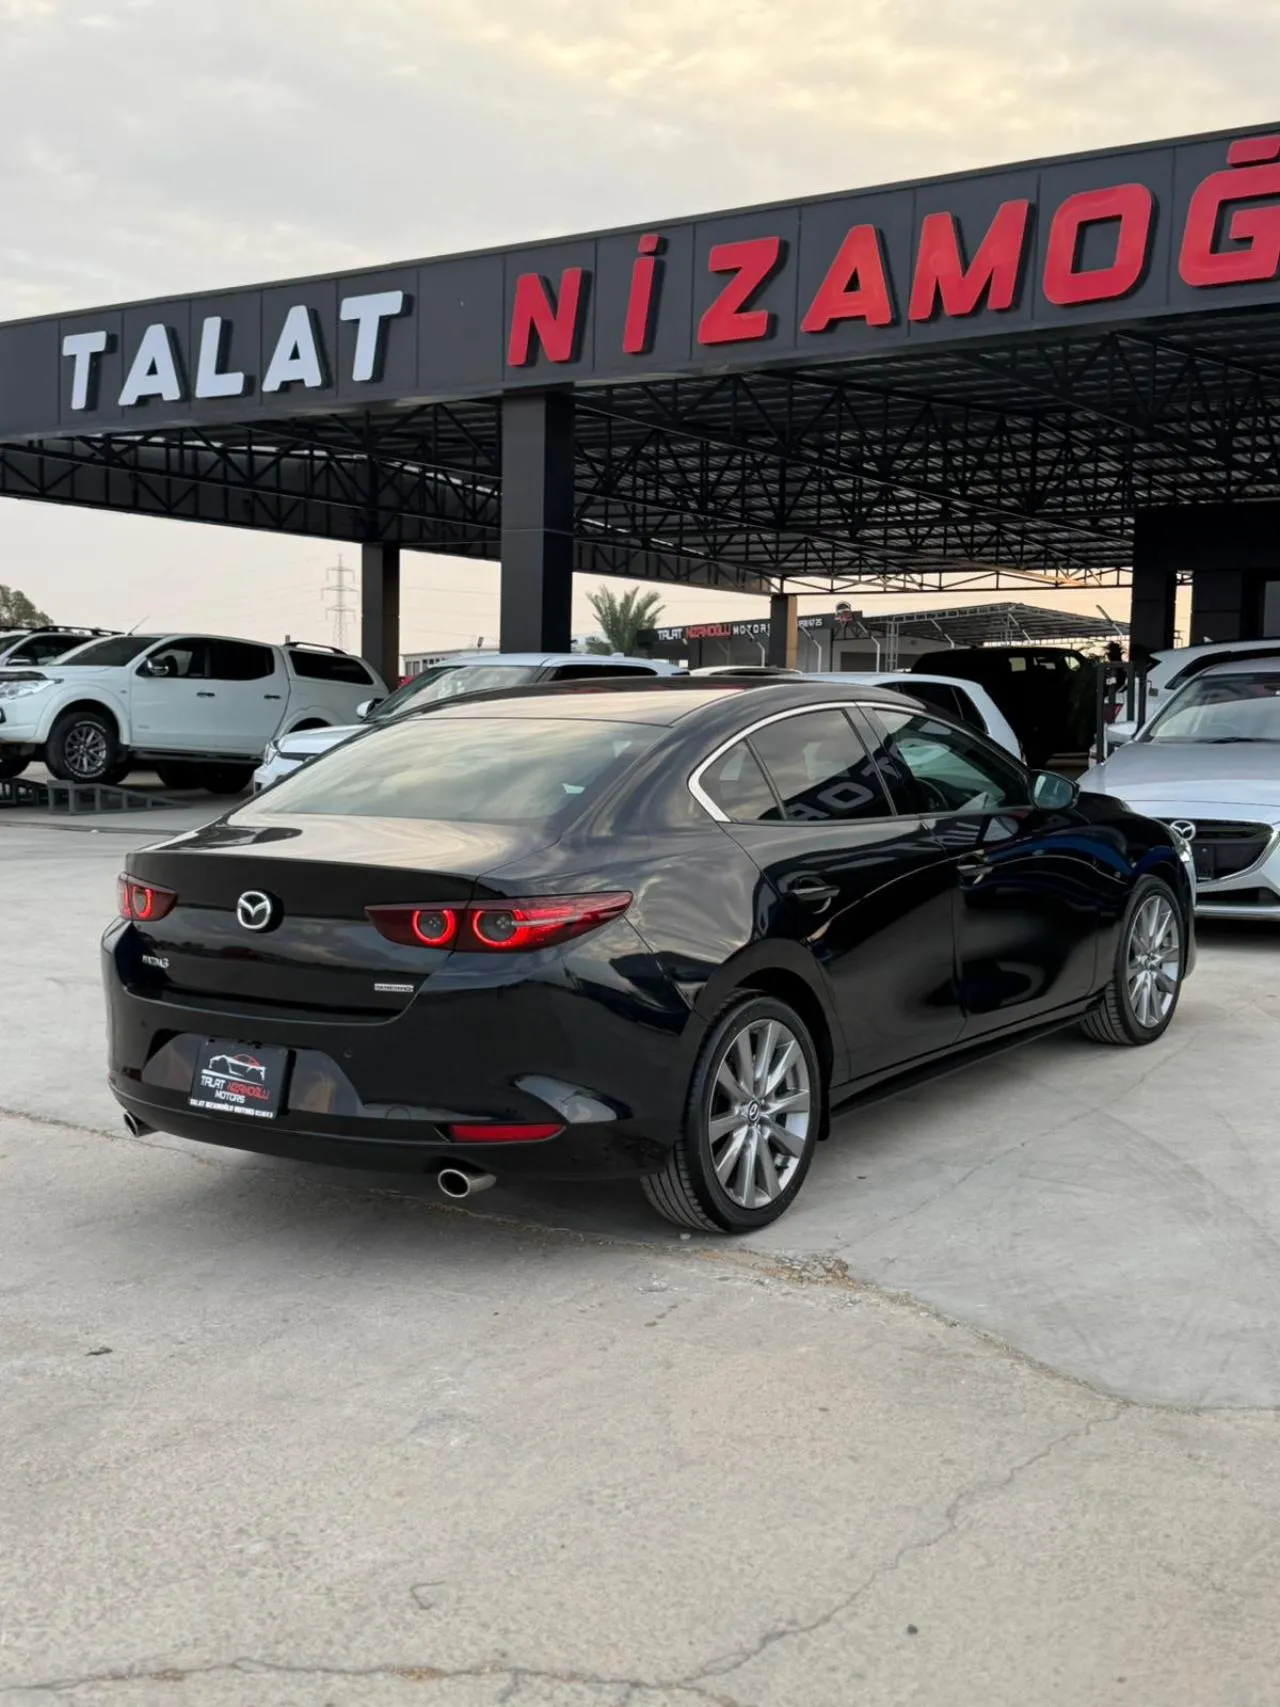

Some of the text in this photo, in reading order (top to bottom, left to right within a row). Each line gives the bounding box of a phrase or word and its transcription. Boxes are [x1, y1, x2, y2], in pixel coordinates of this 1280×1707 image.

[62, 289, 404, 410] TALAT
[657, 628, 682, 640] TALAT
[200, 1075, 226, 1090] TALAT
